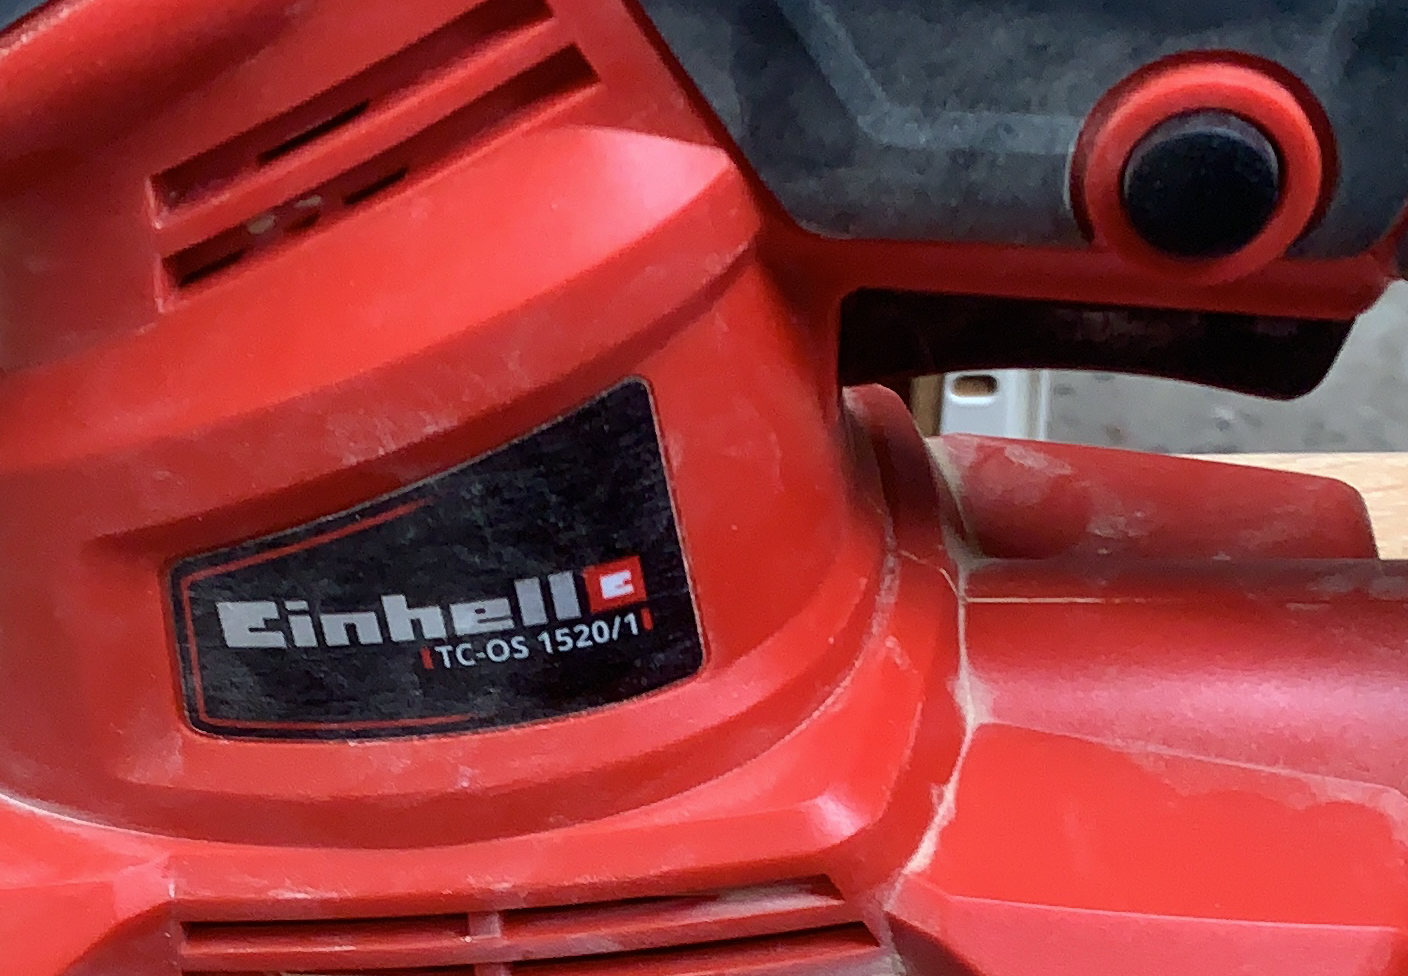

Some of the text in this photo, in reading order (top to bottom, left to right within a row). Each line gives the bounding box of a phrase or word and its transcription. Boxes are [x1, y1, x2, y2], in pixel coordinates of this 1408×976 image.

[216, 571, 582, 648] Einhell
[435, 612, 640, 669] TC-OS 1520/1
